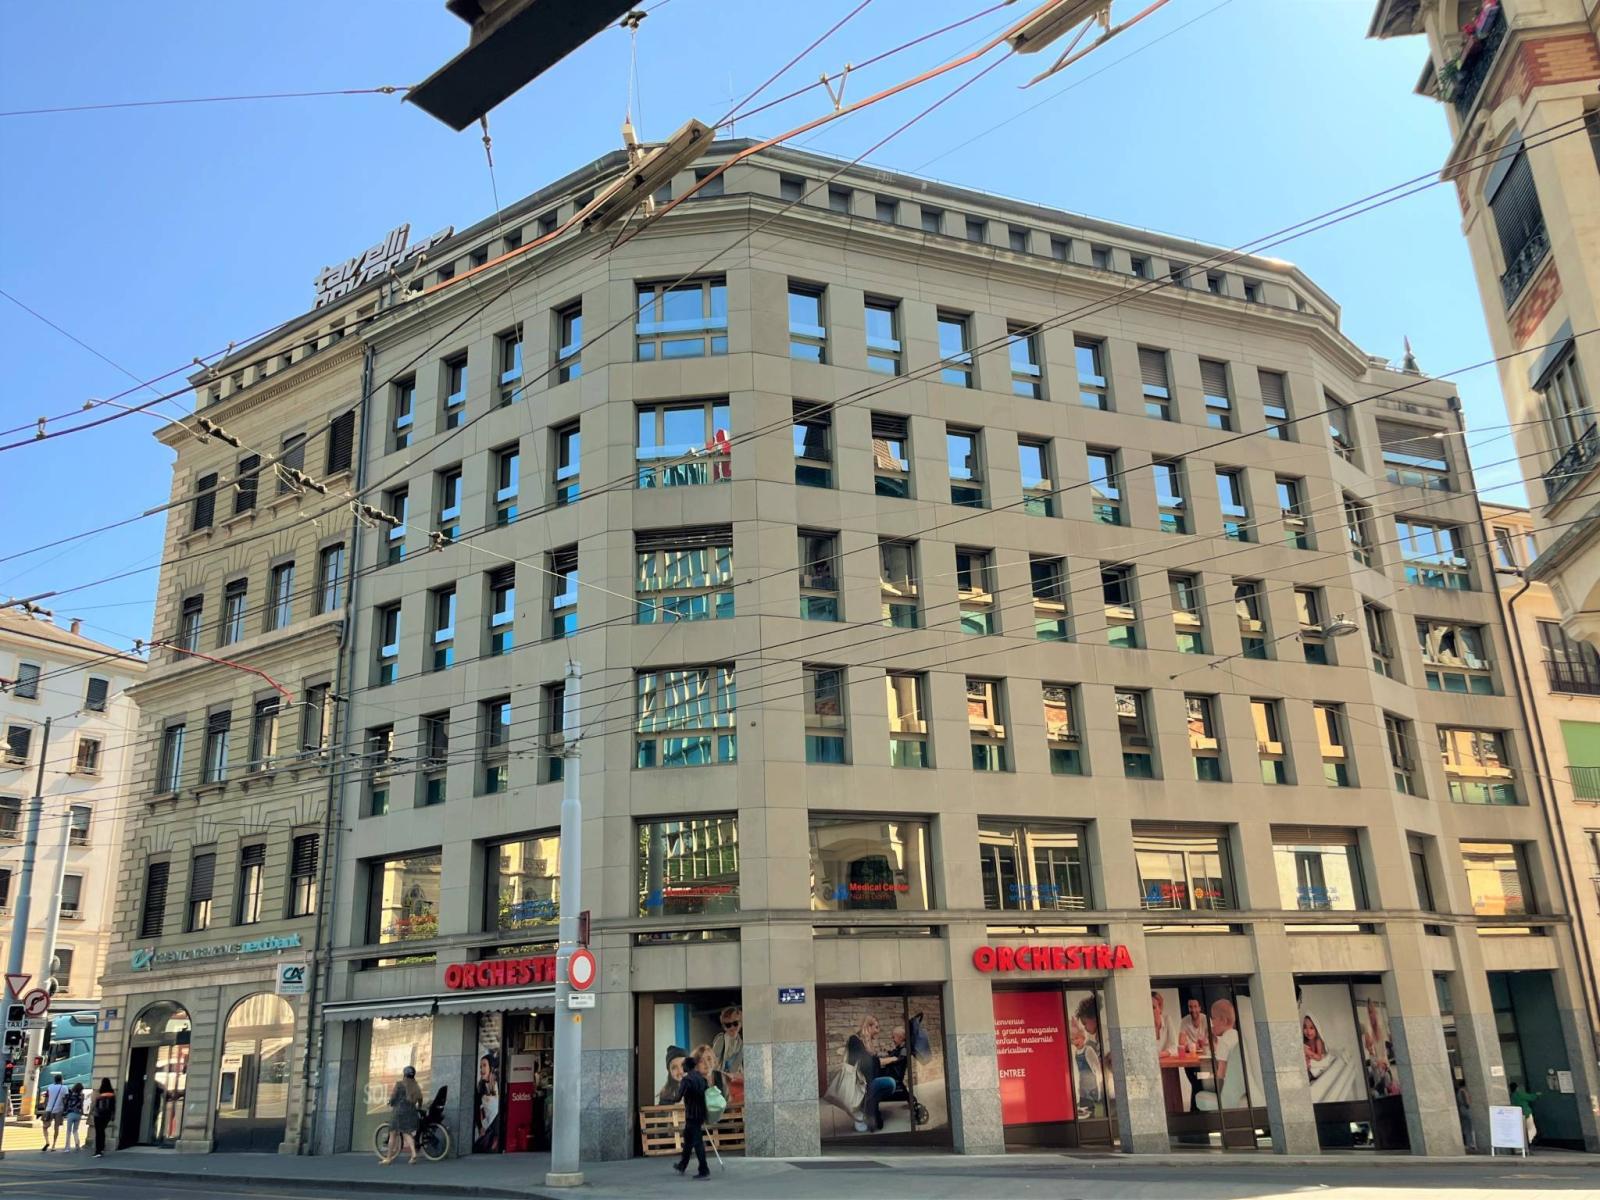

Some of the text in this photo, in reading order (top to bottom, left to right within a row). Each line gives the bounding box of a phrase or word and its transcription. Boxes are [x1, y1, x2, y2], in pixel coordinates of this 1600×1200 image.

[314, 222, 411, 296] tavelli
[973, 944, 1134, 973] ORCHESTRA
[445, 956, 556, 990] ORCHESTR
[994, 1018, 1025, 1026] ienvenue
[1027, 1025, 1059, 1036] magasins
[999, 1068, 1026, 1079] ENTREE
